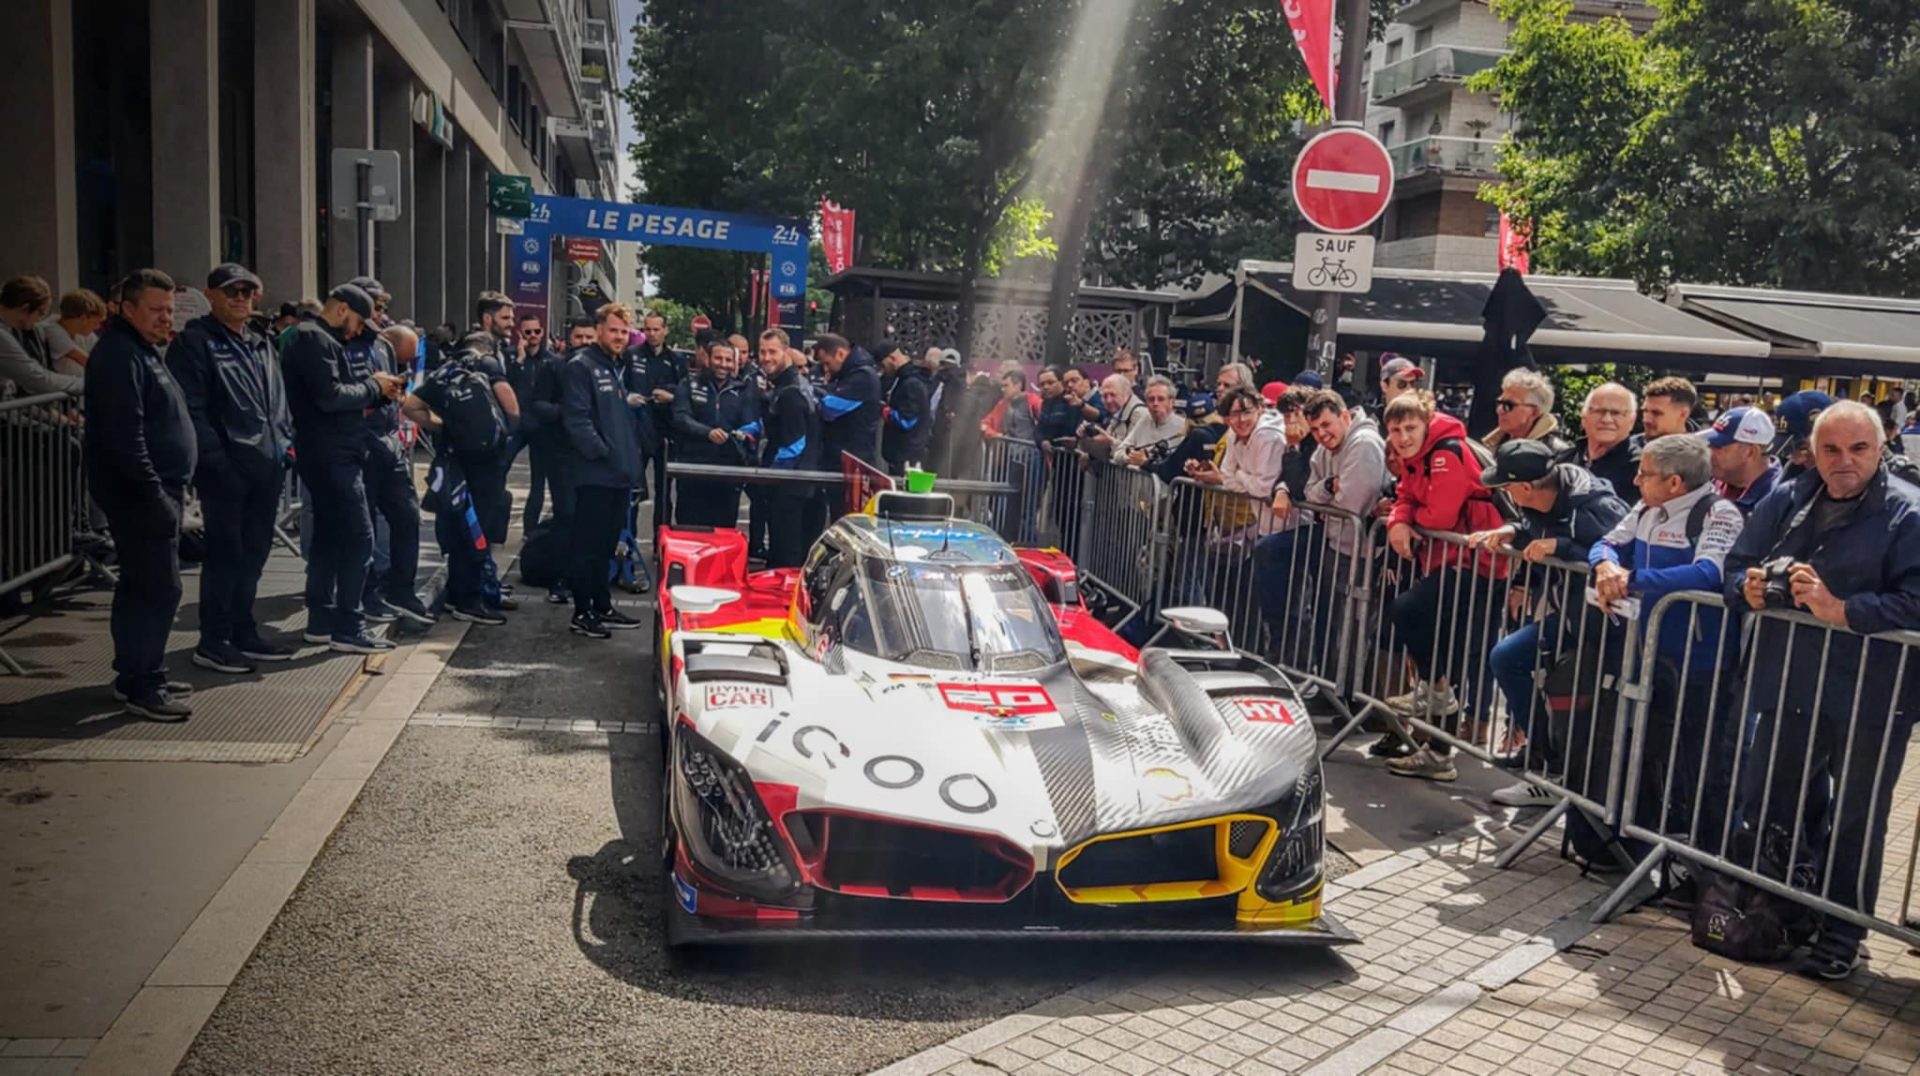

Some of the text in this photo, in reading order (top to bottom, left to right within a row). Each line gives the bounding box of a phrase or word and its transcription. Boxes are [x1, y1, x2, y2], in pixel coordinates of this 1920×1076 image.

[587, 209, 730, 240] LE PESAGE
[1315, 239, 1356, 253] SAUF
[710, 692, 767, 706] CAR
[1238, 702, 1284, 720] HY
